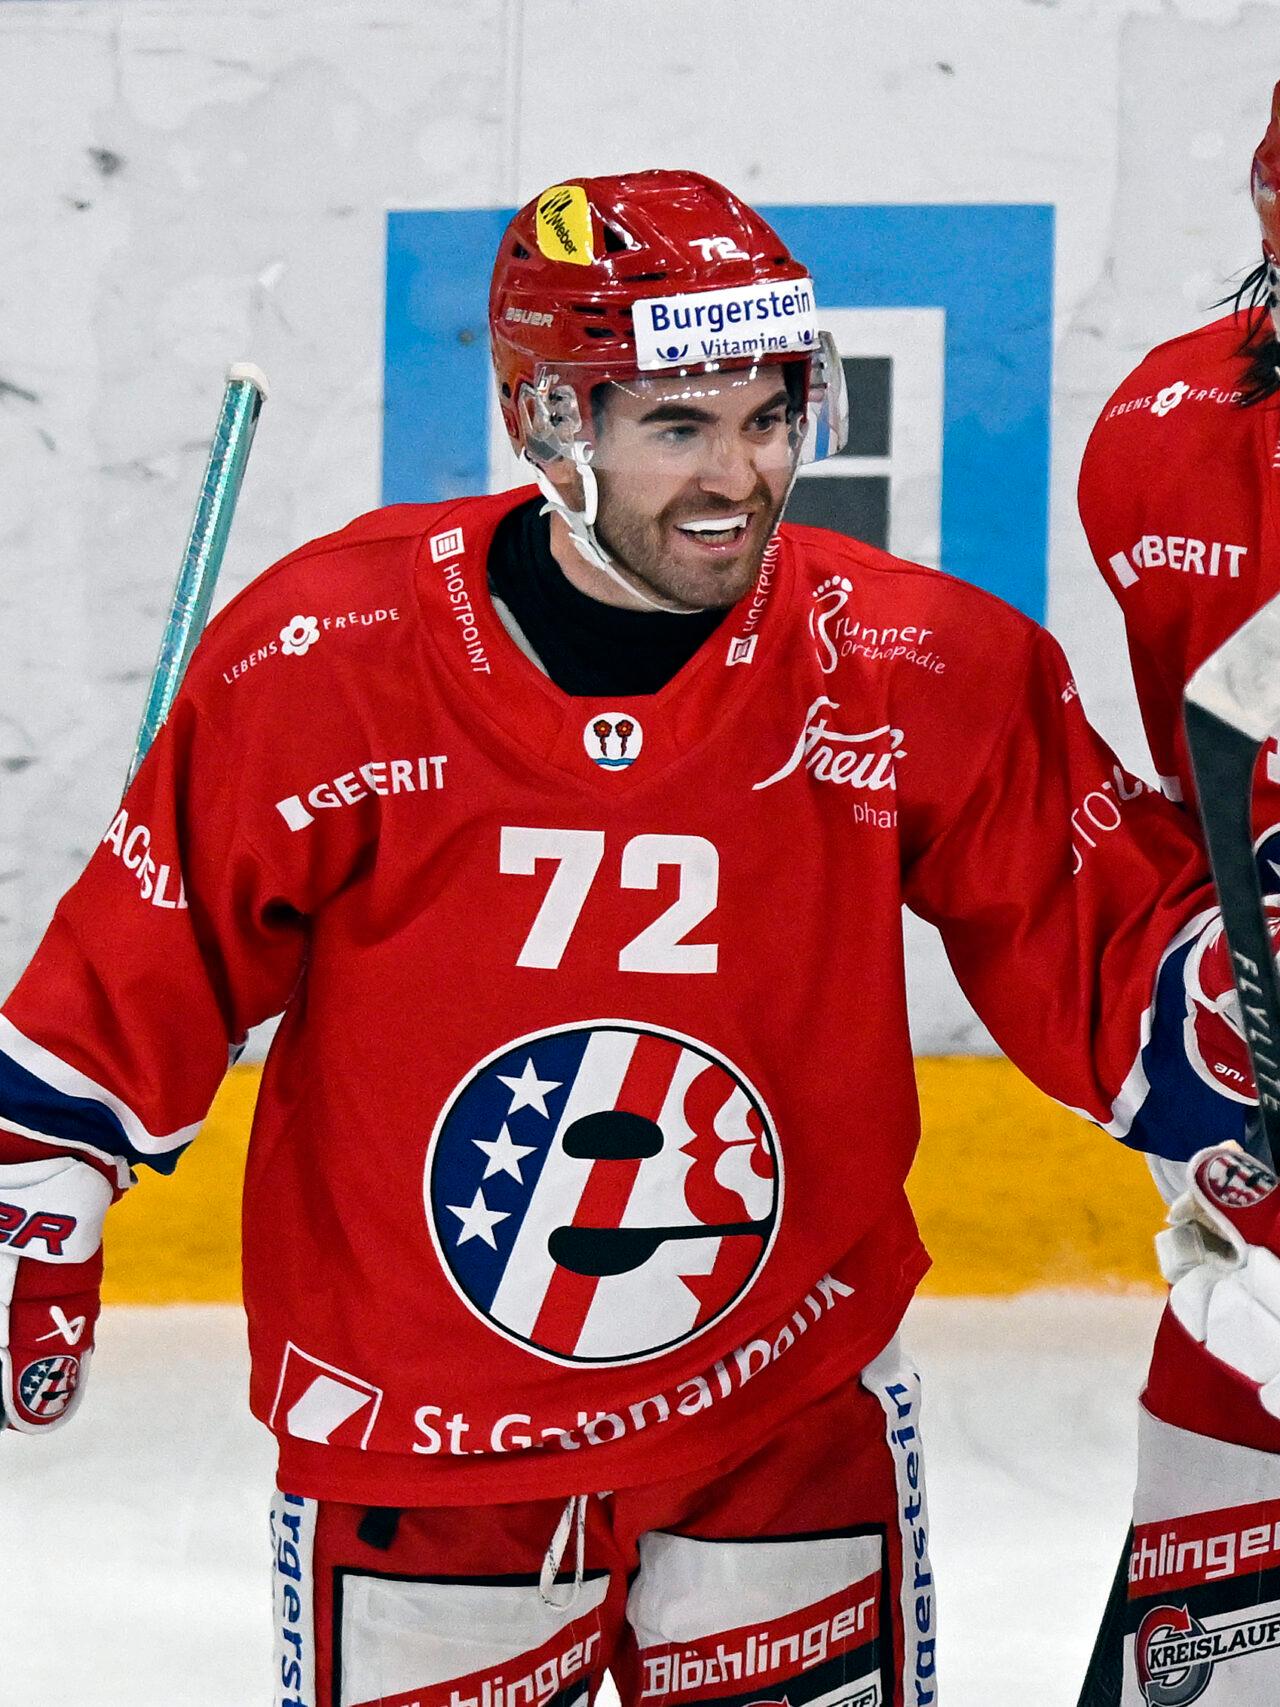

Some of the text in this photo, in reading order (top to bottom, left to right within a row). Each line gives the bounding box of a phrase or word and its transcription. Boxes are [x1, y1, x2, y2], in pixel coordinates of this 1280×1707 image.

[545, 212, 578, 255] Weber
[689, 237, 750, 262] 72
[651, 285, 811, 333] Burgerstein
[700, 333, 788, 359] Vitamine
[1105, 396, 1153, 422] EBENS
[443, 562, 492, 676] HOSTPOINT
[222, 607, 400, 685] LEBENS FREUDE
[499, 825, 720, 975] 72
[641, 1597, 876, 1699] Blöchlinger
